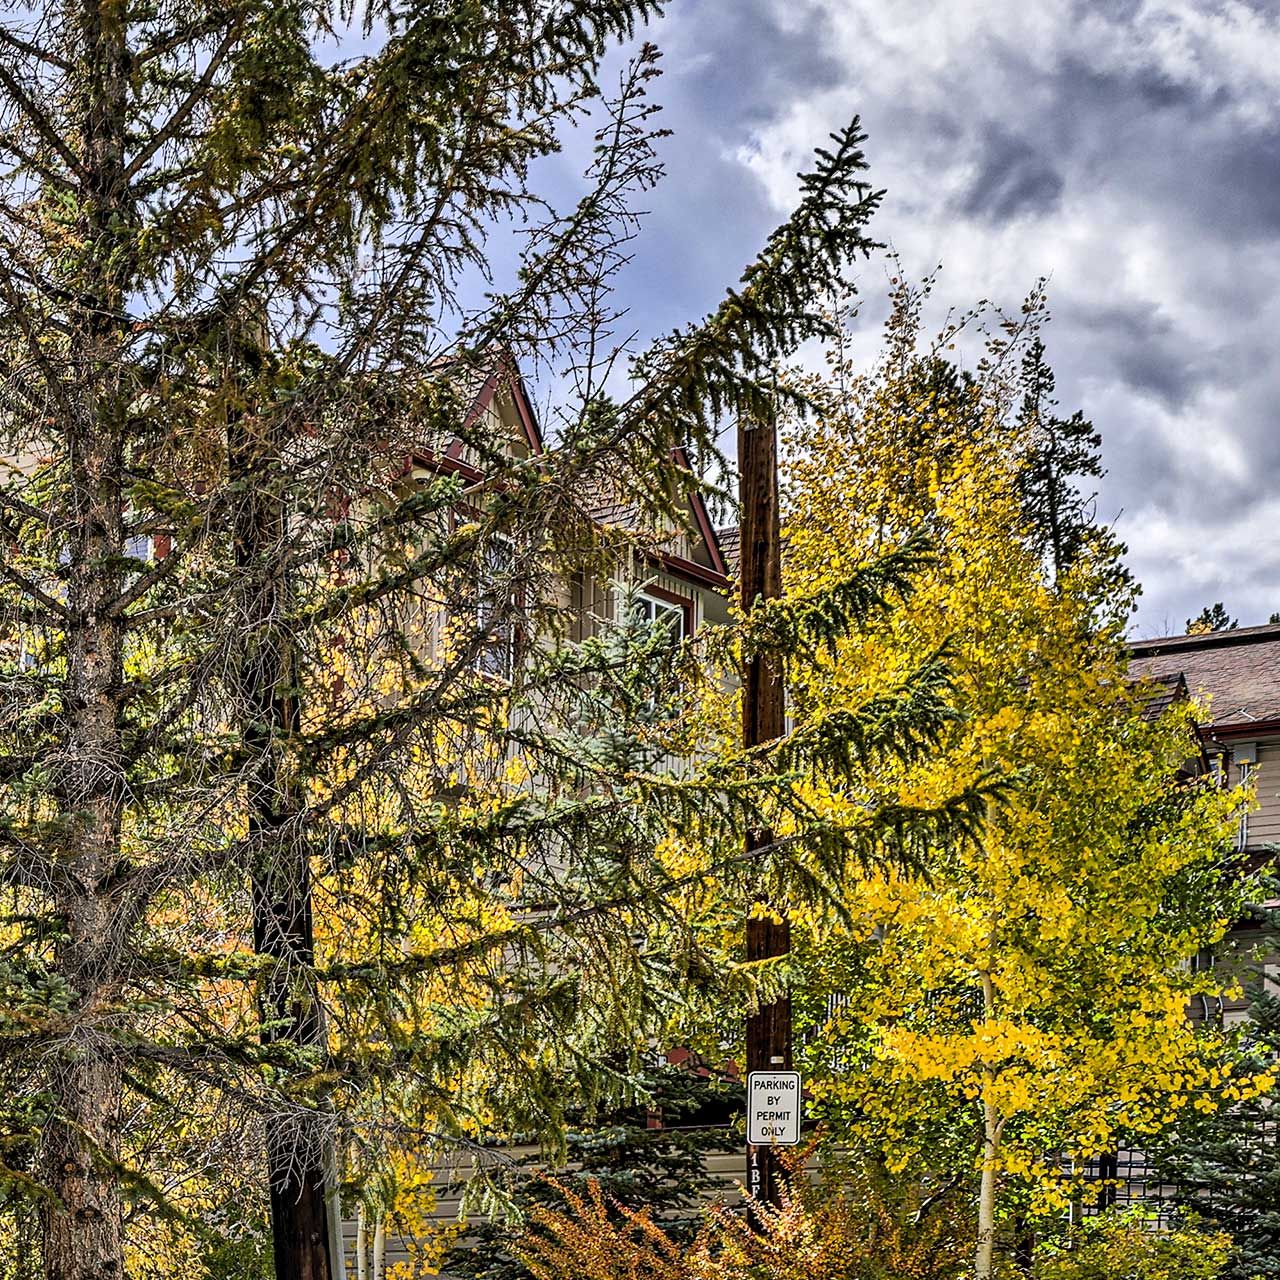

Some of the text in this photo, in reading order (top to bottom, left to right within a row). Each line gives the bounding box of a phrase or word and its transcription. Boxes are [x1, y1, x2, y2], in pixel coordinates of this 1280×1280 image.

[754, 1080, 795, 1090] PARKING
[767, 1096, 781, 1106] BY
[757, 1111, 791, 1120] PERMIT
[761, 1127, 786, 1136] ONLY
